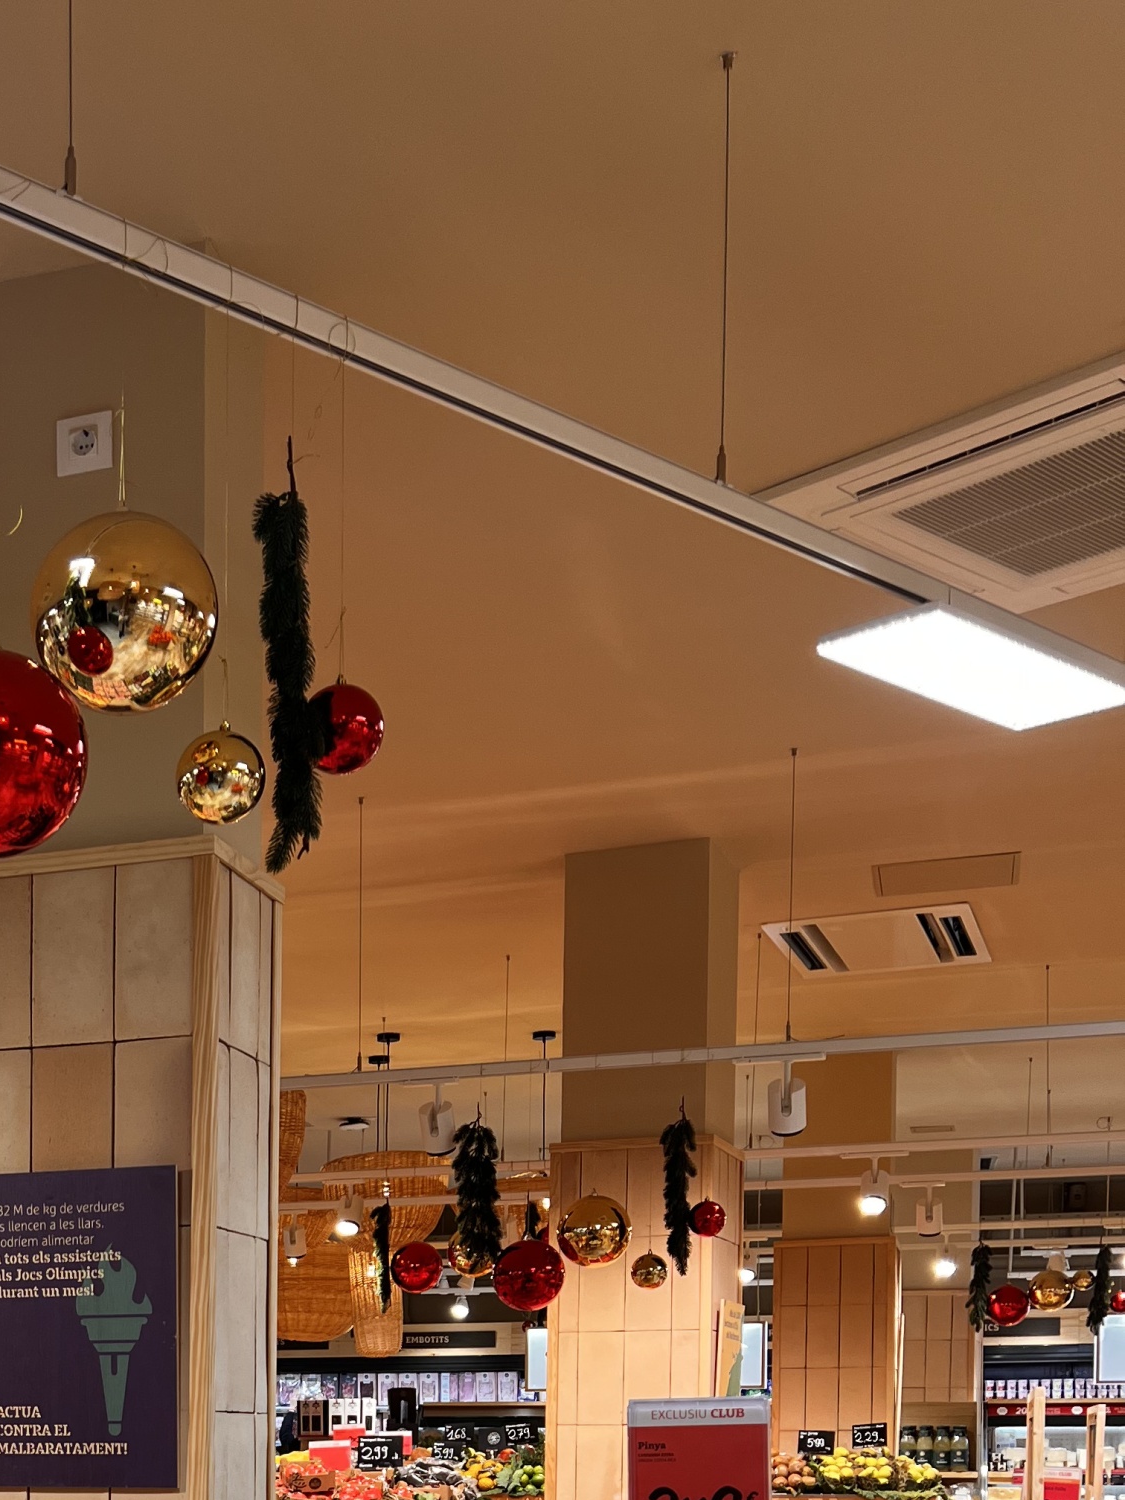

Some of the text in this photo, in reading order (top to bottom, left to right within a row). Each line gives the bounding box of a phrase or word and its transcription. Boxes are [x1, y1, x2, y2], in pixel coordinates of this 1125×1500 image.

[13, 1204, 23, 1216] M
[26, 1204, 40, 1216] de
[43, 1203, 57, 1218] kg
[59, 1202, 73, 1214] de
[76, 1201, 125, 1214] verdures
[8, 1219, 47, 1232] llencen
[50, 1222, 57, 1231] a
[59, 1218, 75, 1230] les
[78, 1217, 104, 1229] llars.
[41, 1234, 95, 1247] alimentar
[4, 1253, 30, 1265] tots
[32, 1251, 51, 1264] els
[54, 1249, 121, 1263] assistents
[15, 1269, 42, 1282] Jocs
[46, 1266, 104, 1283] Olímpics
[42, 1287, 60, 1298] un
[62, 1284, 95, 1297] mes!
[405, 1335, 450, 1344] EMBOTITS
[651, 1408, 745, 1420] EXCLUSIU CLUB
[54, 1424, 71, 1437] EL
[638, 1441, 666, 1452] Pinya
